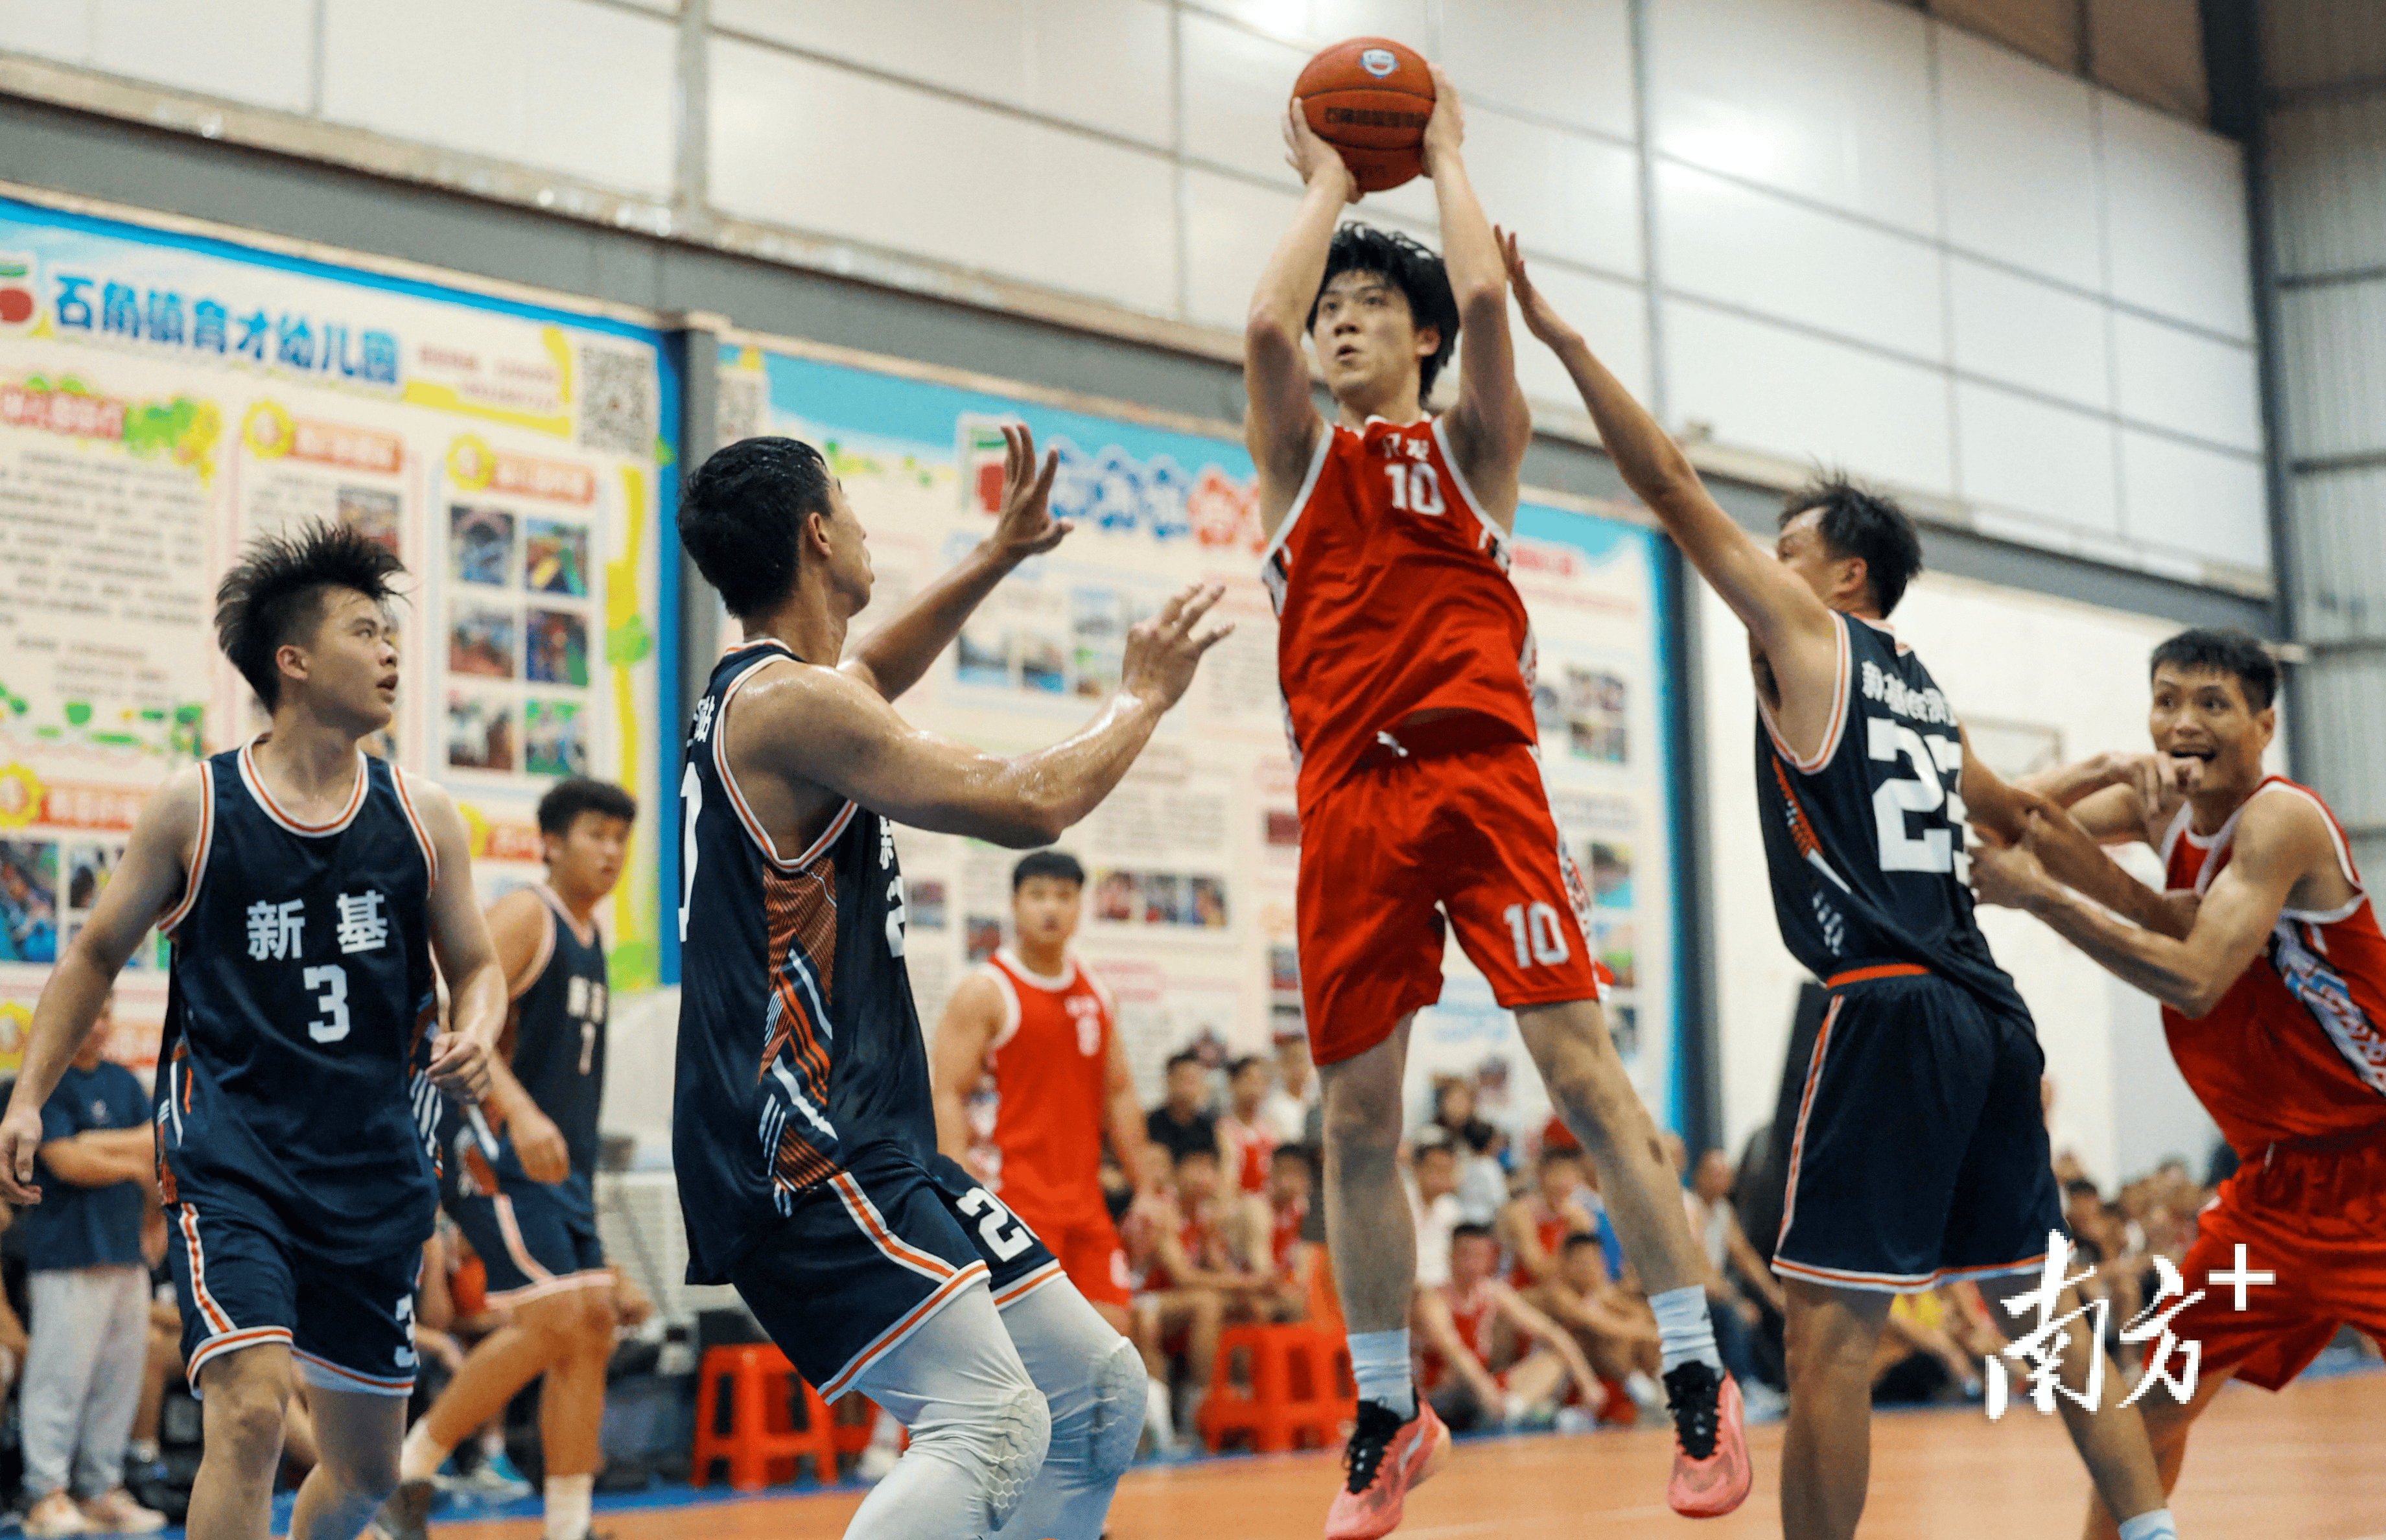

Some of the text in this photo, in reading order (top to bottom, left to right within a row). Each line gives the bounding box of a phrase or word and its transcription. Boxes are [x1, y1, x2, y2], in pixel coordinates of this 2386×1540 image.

[1385, 463, 1445, 516] 10
[246, 889, 388, 961] 新基
[1503, 900, 1570, 969] 10
[303, 964, 351, 1044] 3
[956, 1187, 1039, 1262] 2
